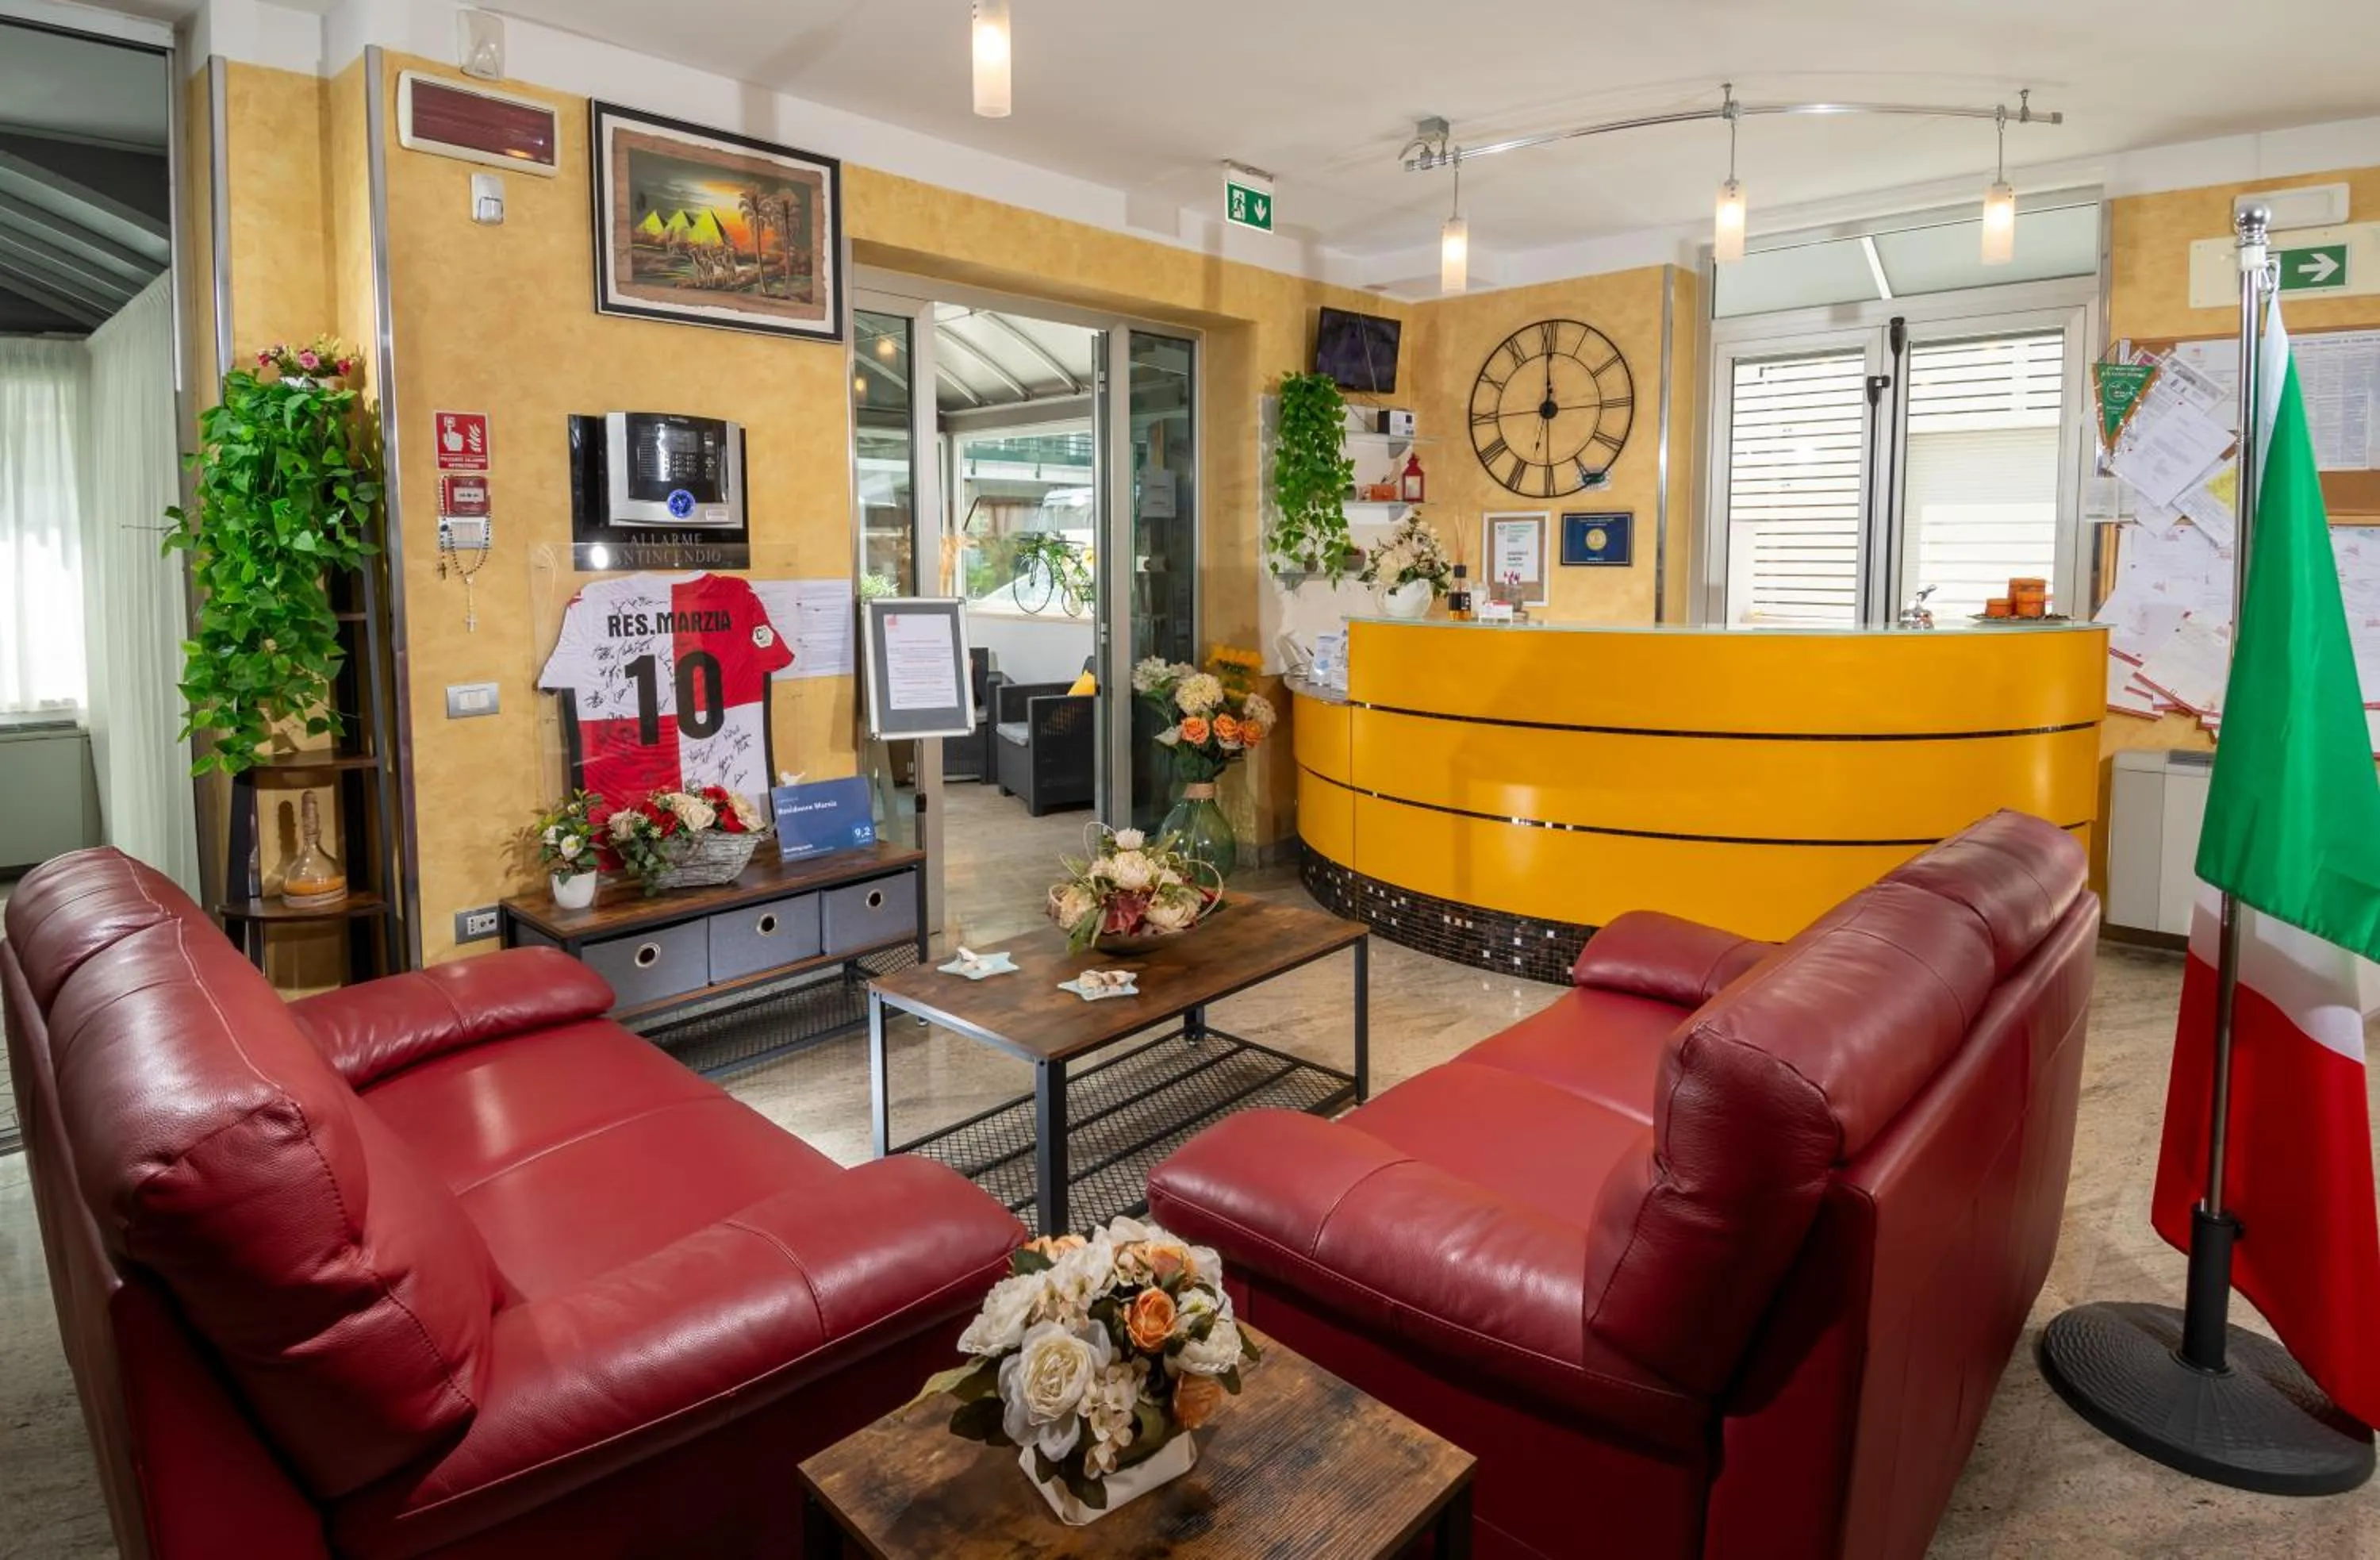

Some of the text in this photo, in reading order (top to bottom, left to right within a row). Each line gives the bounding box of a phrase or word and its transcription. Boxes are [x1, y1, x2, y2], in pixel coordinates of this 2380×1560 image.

[630, 532, 704, 547] ALLARME
[607, 609, 732, 637] RES.MARZIA
[624, 651, 724, 746] 10
